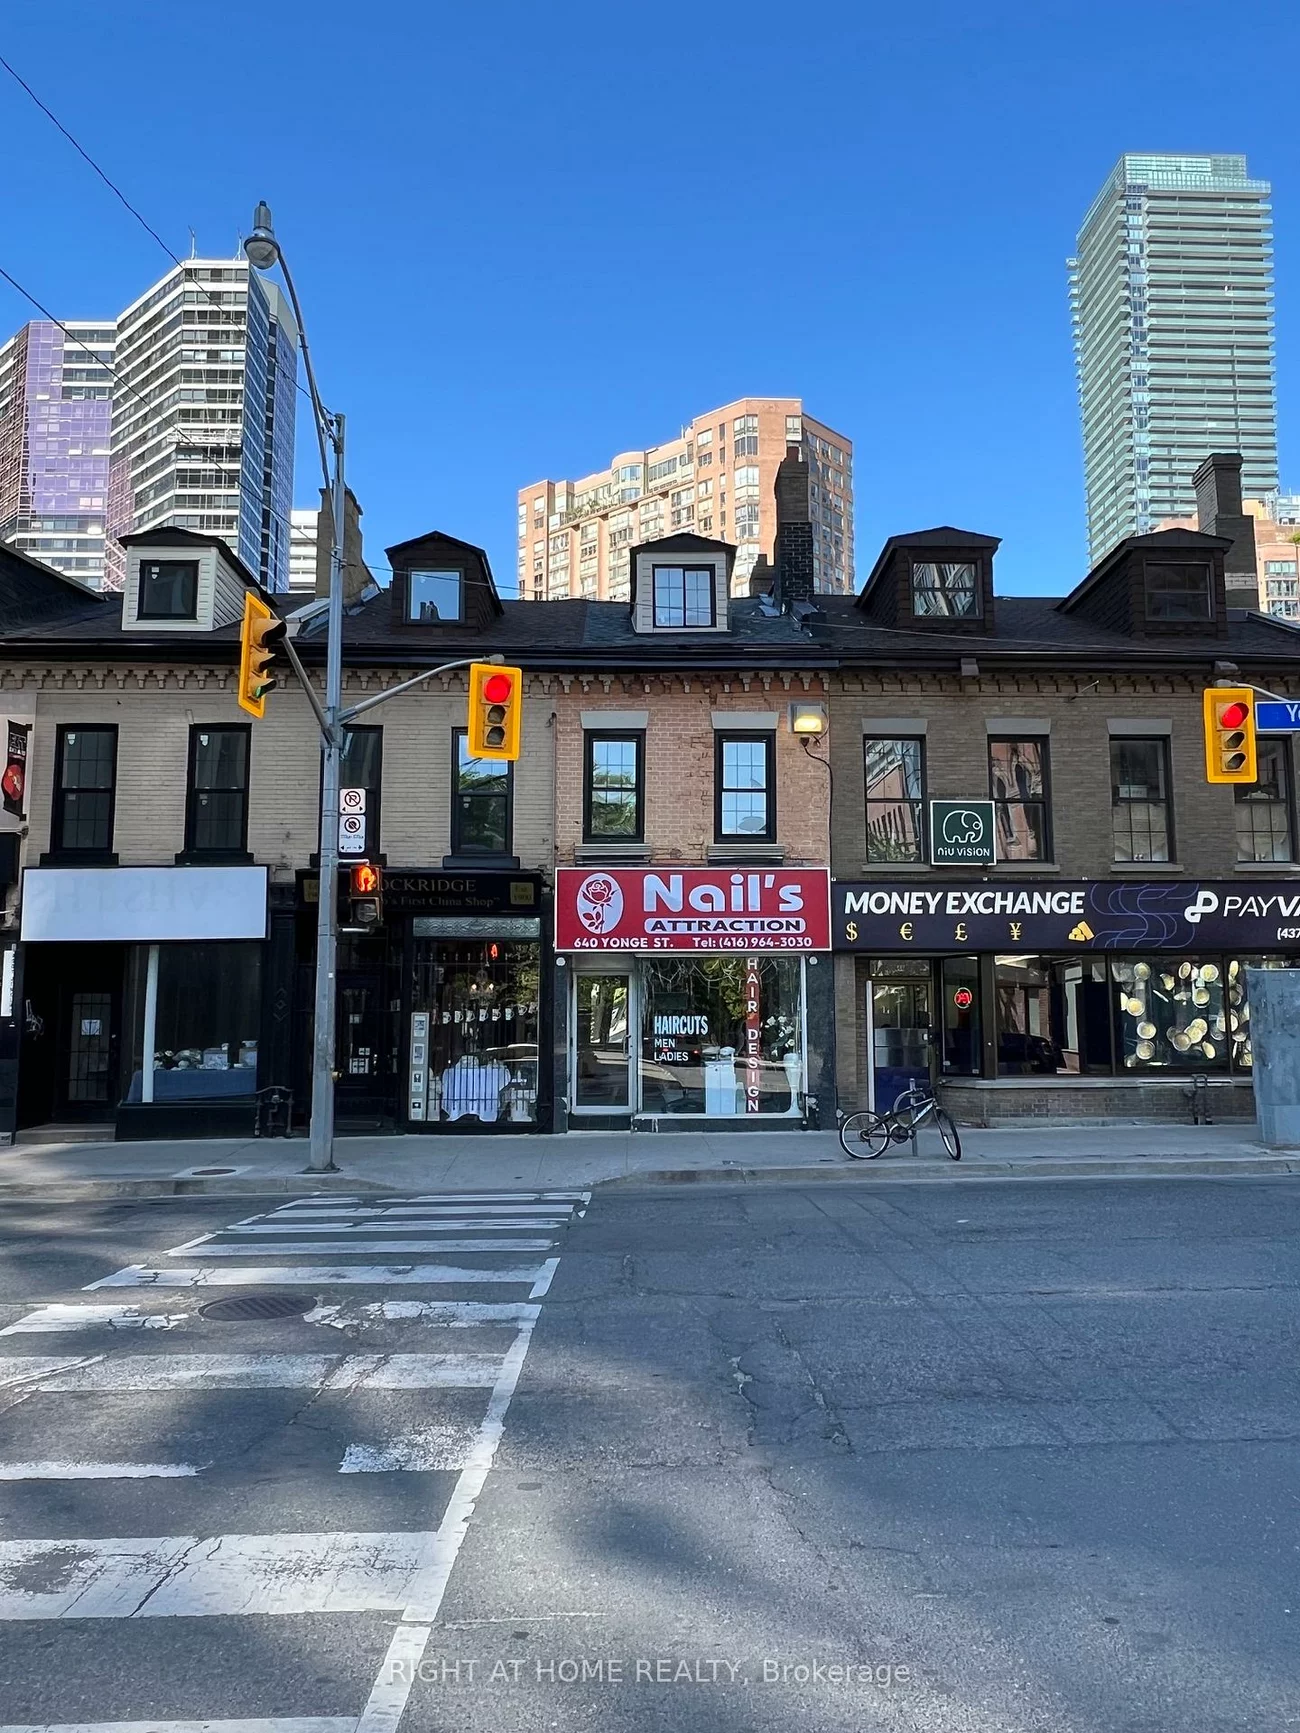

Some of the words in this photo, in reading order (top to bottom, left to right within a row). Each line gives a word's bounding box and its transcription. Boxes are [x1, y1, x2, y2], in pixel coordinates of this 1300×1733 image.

[1286, 704, 1300, 722] Y
[428, 896, 462, 907] China
[643, 873, 804, 913] Nail's
[844, 891, 944, 915] MONEY
[945, 891, 1086, 915] EXCHANGE
[650, 919, 801, 932] ATTRACTION
[845, 921, 858, 942] $
[899, 922, 913, 941] €
[954, 923, 968, 941] £
[1008, 922, 1022, 941] ¥
[573, 937, 598, 948] 640
[601, 937, 648, 948] YONGE
[653, 937, 674, 948] ST.
[692, 937, 716, 948] Tel:
[719, 936, 749, 949] (416)
[750, 937, 813, 948] 964-3030
[746, 957, 759, 1013] HAIR
[654, 1015, 709, 1035] HAIRCUTS
[654, 1038, 675, 1048] MEN
[653, 1051, 689, 1061] LADIES
[747, 1028, 759, 1112] DESIGN
